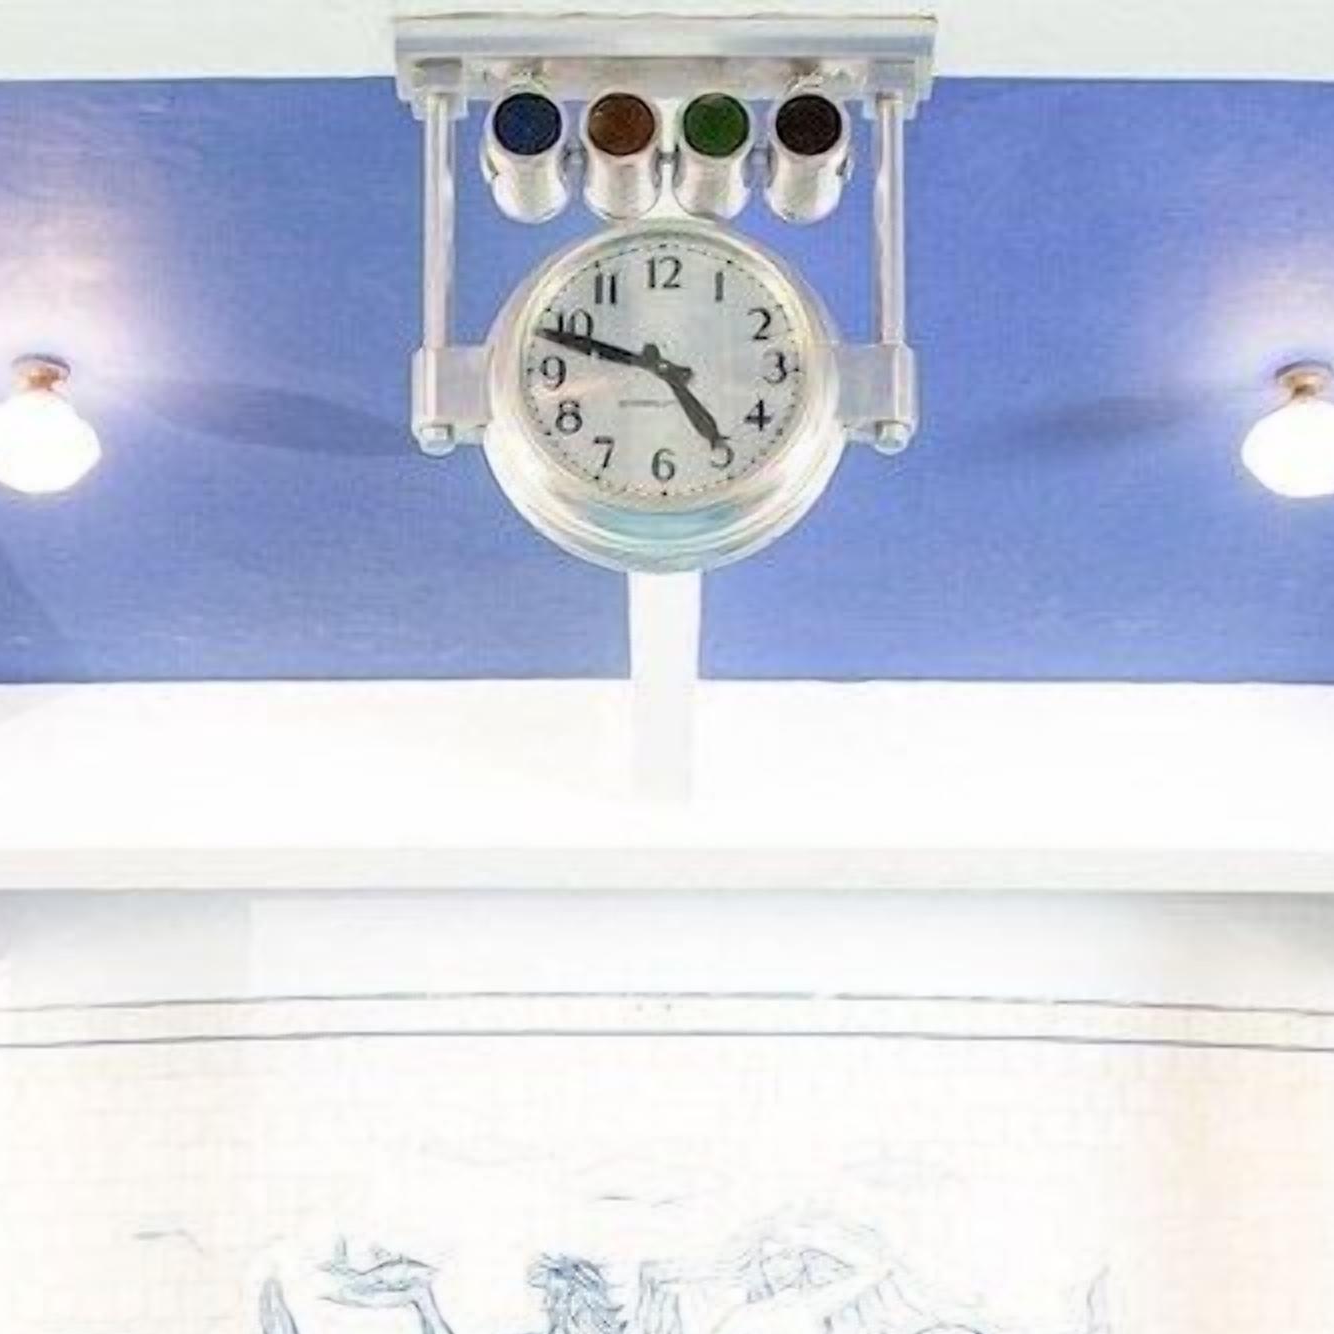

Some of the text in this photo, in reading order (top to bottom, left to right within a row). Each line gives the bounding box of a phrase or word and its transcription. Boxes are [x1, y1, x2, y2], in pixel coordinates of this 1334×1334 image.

[594, 273, 618, 304] 11
[645, 256, 683, 289] 12
[714, 271, 725, 302] 1
[556, 309, 595, 341] 10
[748, 308, 772, 341] 2
[540, 356, 567, 391] 9
[764, 351, 788, 384] 3
[555, 400, 584, 435] 8
[744, 398, 772, 432] 4
[593, 436, 616, 470] 7
[651, 447, 677, 482] 6
[710, 436, 735, 470] 5
